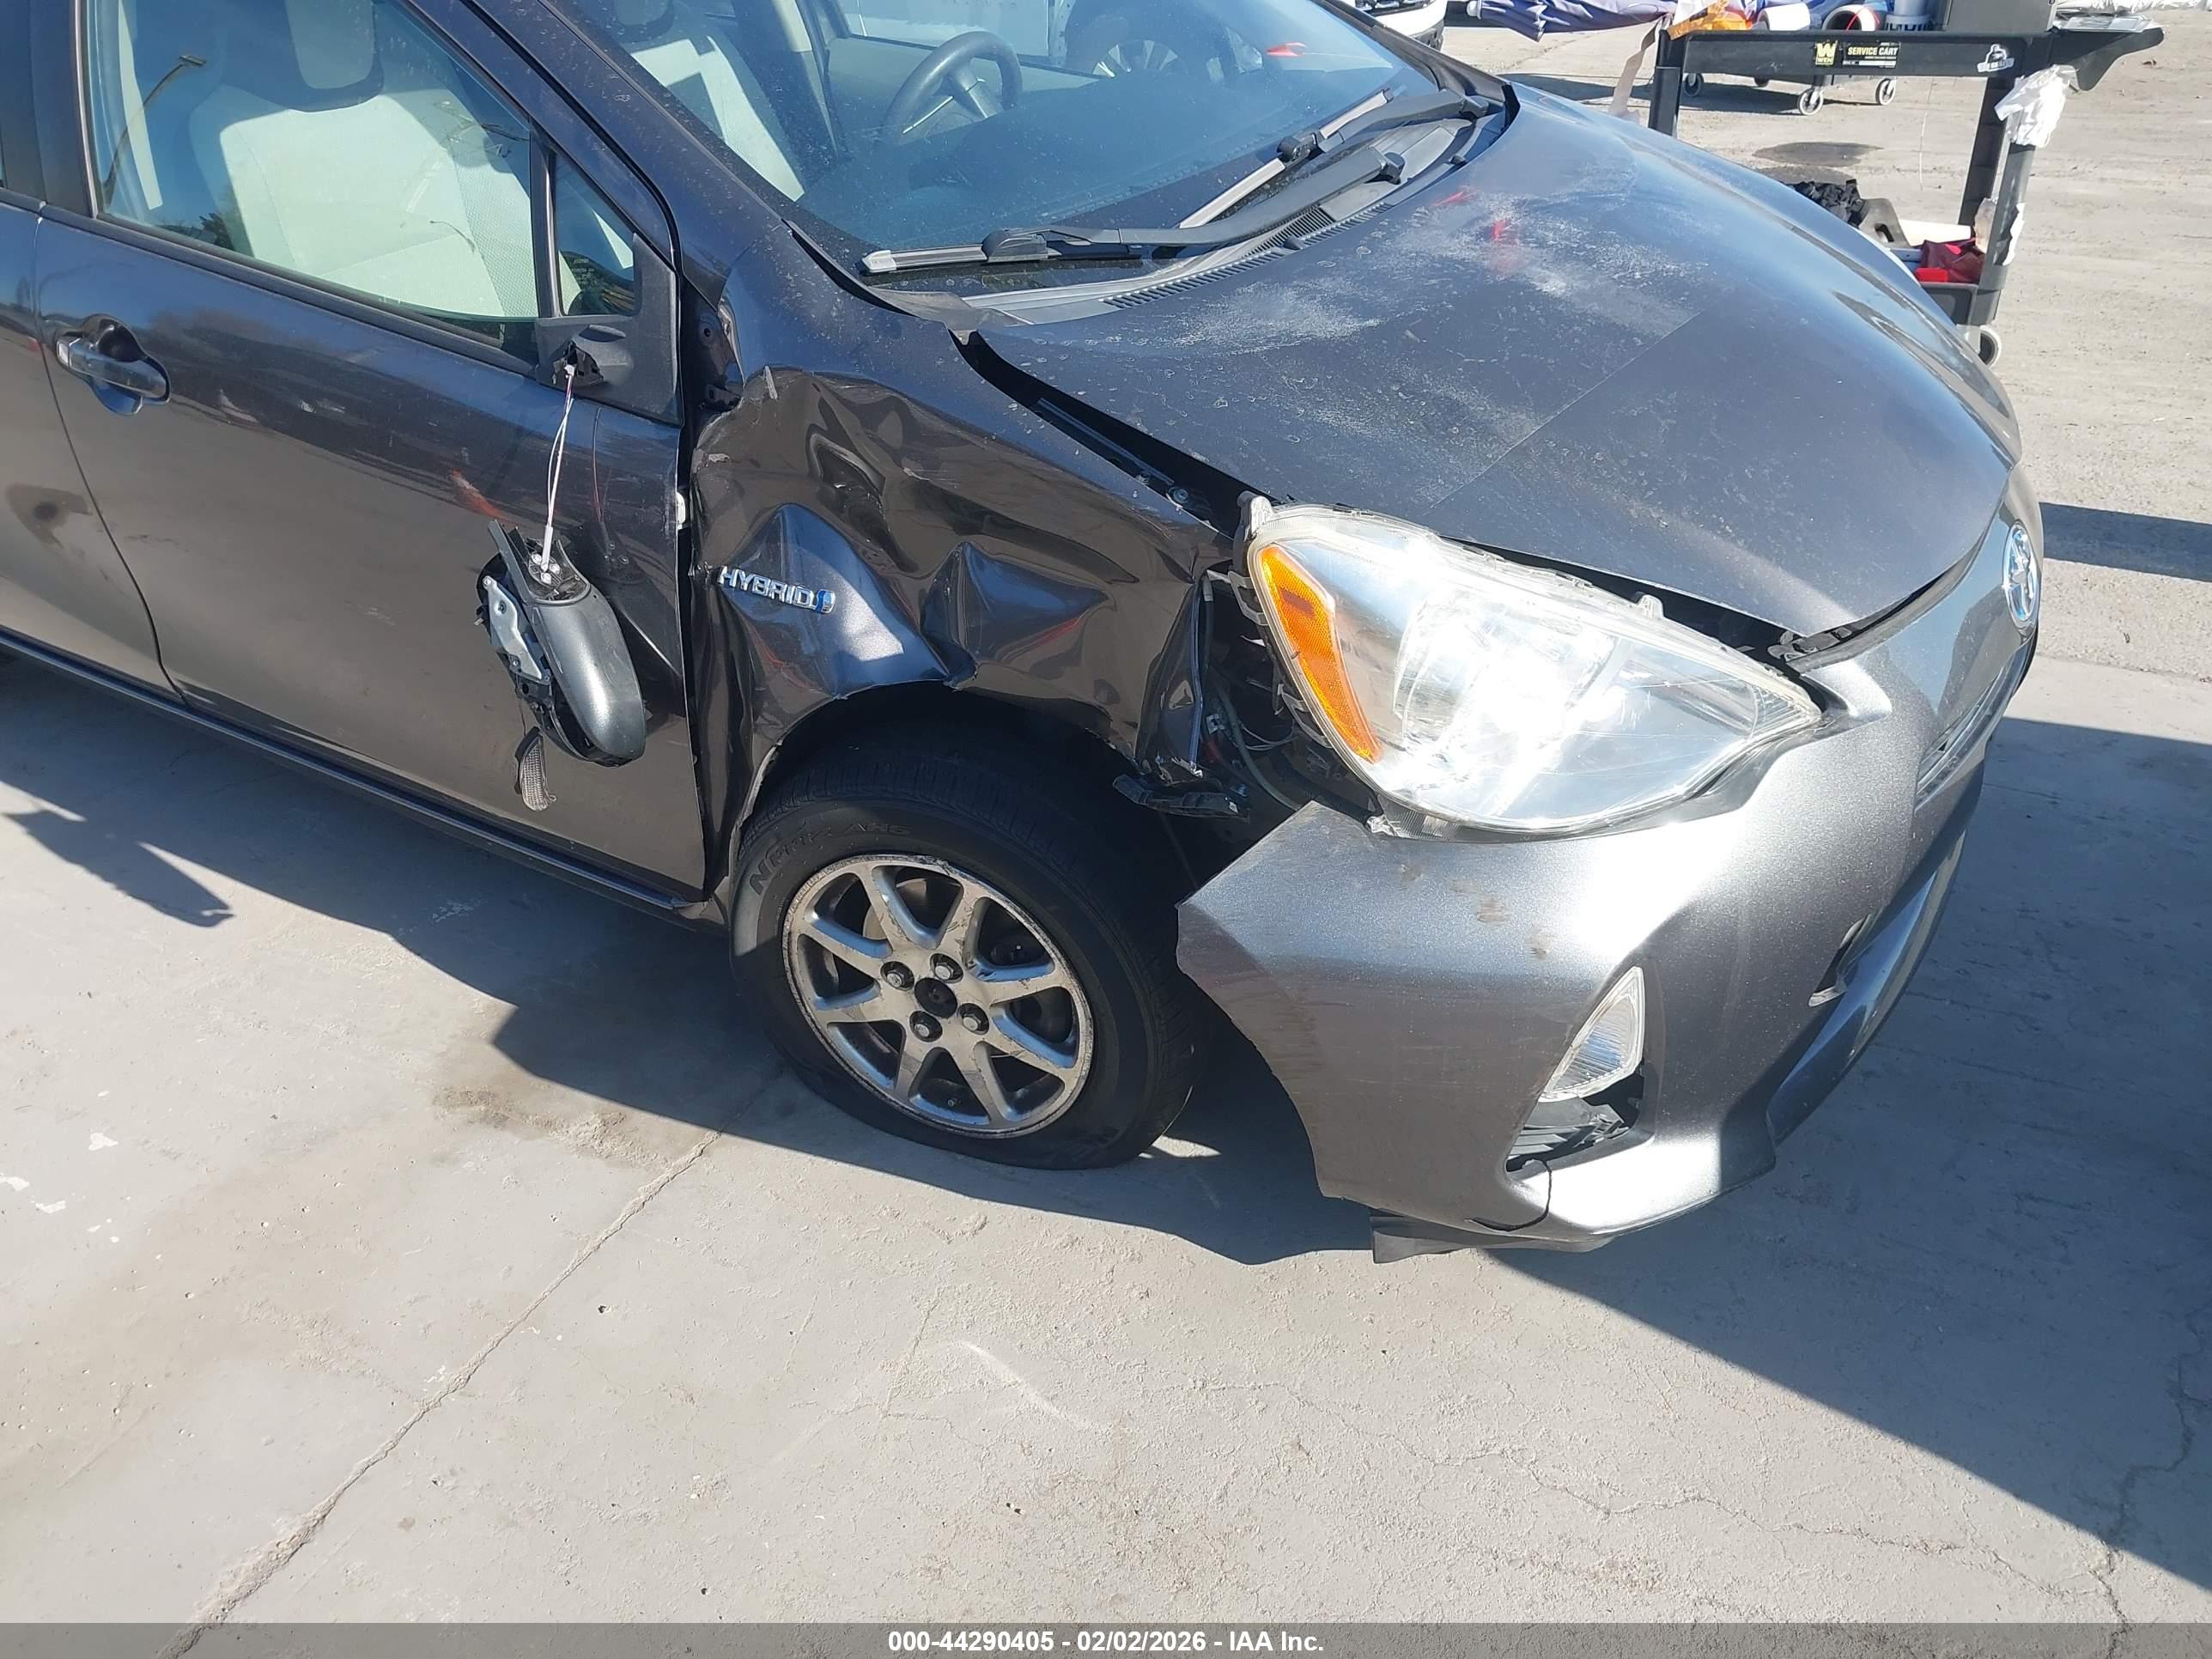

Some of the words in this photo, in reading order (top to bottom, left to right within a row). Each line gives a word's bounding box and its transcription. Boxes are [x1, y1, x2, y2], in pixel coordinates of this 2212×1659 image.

[1847, 46, 1878, 56] SERVICE
[1878, 46, 1899, 56] CART
[716, 565, 811, 609] HYBRID
